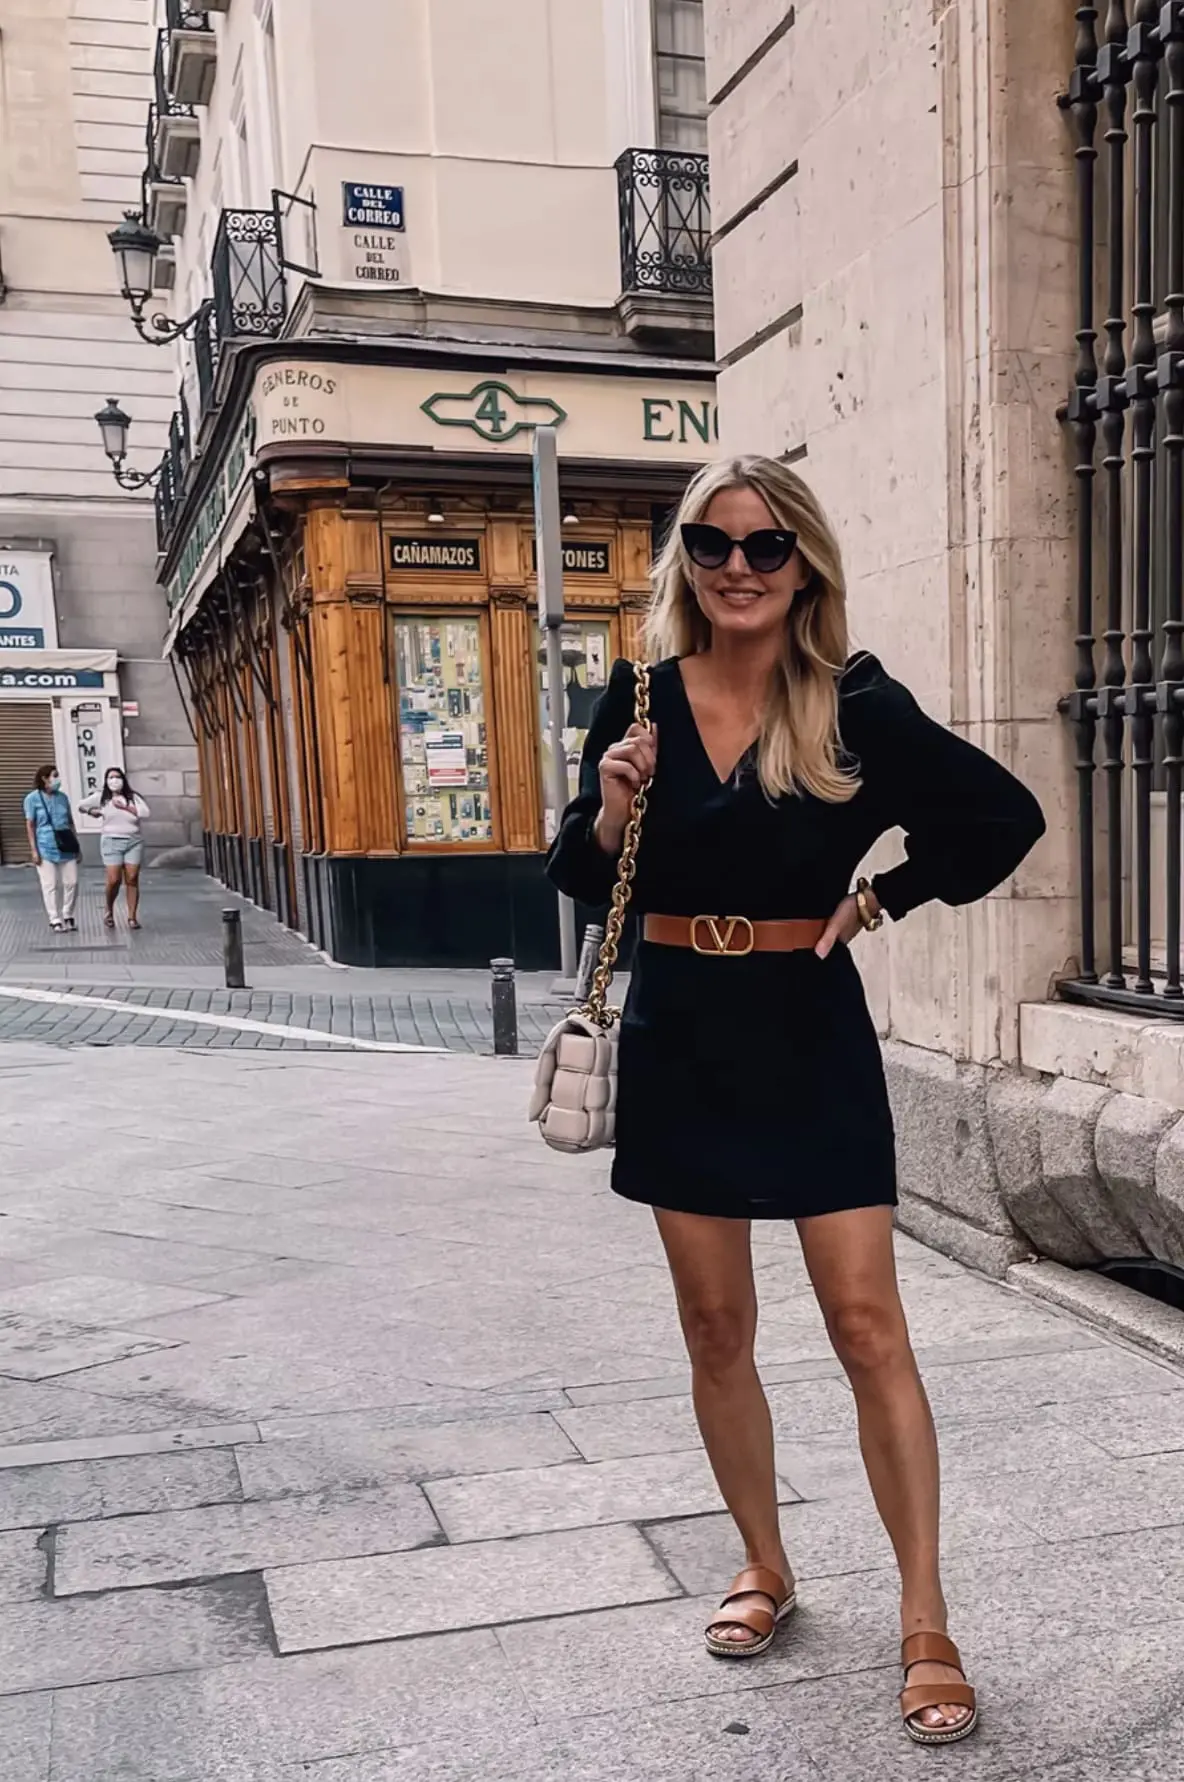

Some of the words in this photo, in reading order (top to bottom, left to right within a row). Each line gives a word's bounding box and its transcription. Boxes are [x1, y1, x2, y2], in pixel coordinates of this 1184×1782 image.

[353, 187, 393, 200] CALLE
[362, 200, 386, 209] DEL
[348, 207, 401, 225] CORREO
[354, 234, 396, 250] CALLE
[366, 252, 385, 264] DEL
[355, 266, 400, 281] CORREO
[283, 396, 299, 407] DE
[475, 390, 506, 433] 4
[272, 418, 325, 434] PUNTO
[641, 398, 718, 444] EN
[393, 542, 474, 565] CAÑAMAZOS
[0, 564, 20, 576] TA
